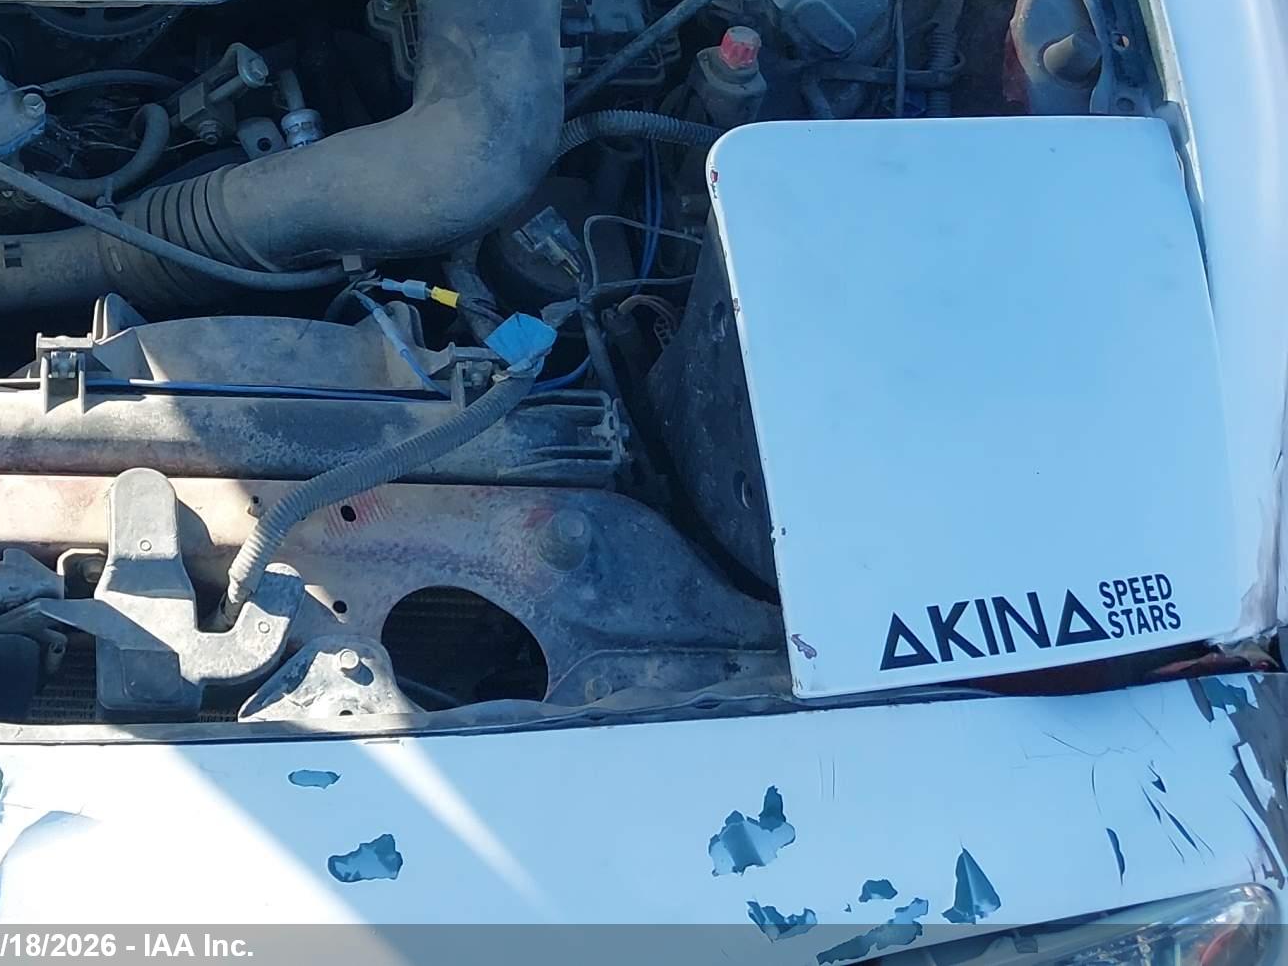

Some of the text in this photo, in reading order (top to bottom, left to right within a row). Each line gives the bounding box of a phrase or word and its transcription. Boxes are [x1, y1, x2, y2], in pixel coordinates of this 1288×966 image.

[1098, 573, 1173, 609] SPEED
[879, 588, 1112, 671] AKINA
[1107, 602, 1182, 639] STARS
